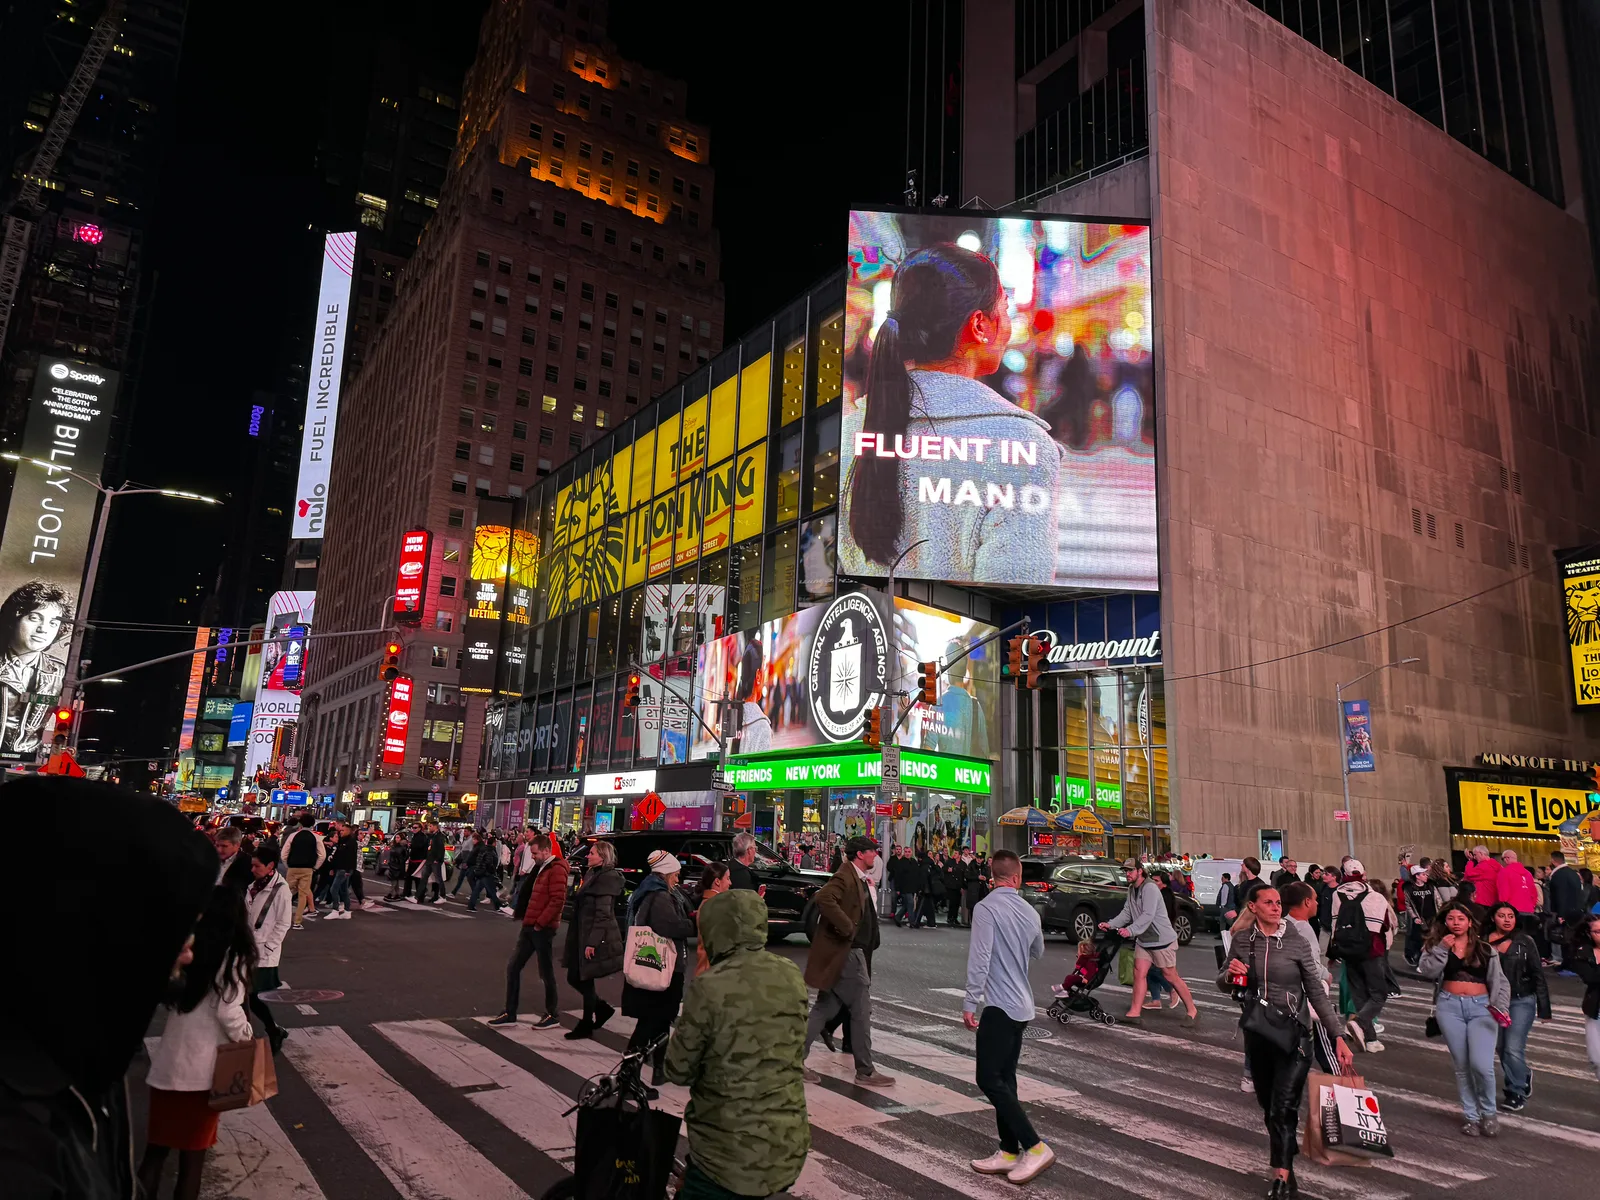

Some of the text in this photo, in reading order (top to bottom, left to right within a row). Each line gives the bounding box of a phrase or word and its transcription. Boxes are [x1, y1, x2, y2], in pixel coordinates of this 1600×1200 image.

[316, 303, 340, 410] INCREDIBLE
[69, 370, 105, 386] Spotify
[52, 387, 98, 402] CELEBRATING
[57, 395, 71, 403] THE
[43, 400, 90, 414] ANNIVERSARY
[50, 408, 91, 421] PIANO MAN
[310, 415, 327, 463] FUEL
[670, 425, 705, 472] THE
[854, 432, 1037, 466] FLUENT IN
[46, 424, 79, 493] BILLY
[308, 483, 326, 534] nulo
[632, 456, 756, 565] LION KING
[30, 497, 64, 564] JOEL
[404, 544, 423, 552] OPEN
[406, 536, 423, 544] NOW
[650, 538, 719, 573] ENTRANCE ON 45TH STREET
[480, 583, 495, 592] THE
[476, 591, 498, 602] SHOW
[477, 601, 493, 610] OF A
[469, 608, 501, 620] LIFETIME
[812, 599, 887, 692] CENTRAL INTELLIGENCE AGENCY
[1021, 629, 1161, 672] Paramount
[1583, 654, 1600, 663] TH
[1581, 667, 1600, 682] LIO
[936, 711, 945, 722] IN
[517, 723, 560, 753] SPORTS
[1482, 752, 1557, 770] MINSKOFF
[736, 767, 772, 783] FRIENDS
[786, 763, 841, 781] NEW YORK
[858, 760, 938, 780] LINE IENDS
[883, 764, 898, 778] 25
[955, 767, 982, 784] NEW
[527, 779, 579, 795] SKECHERS
[1488, 788, 1580, 831] THE LION
[1074, 825, 1103, 834] SABRETT
[1355, 1095, 1365, 1112] I
[1355, 1111, 1385, 1132] NY
[1358, 1130, 1387, 1145] GIFTS
